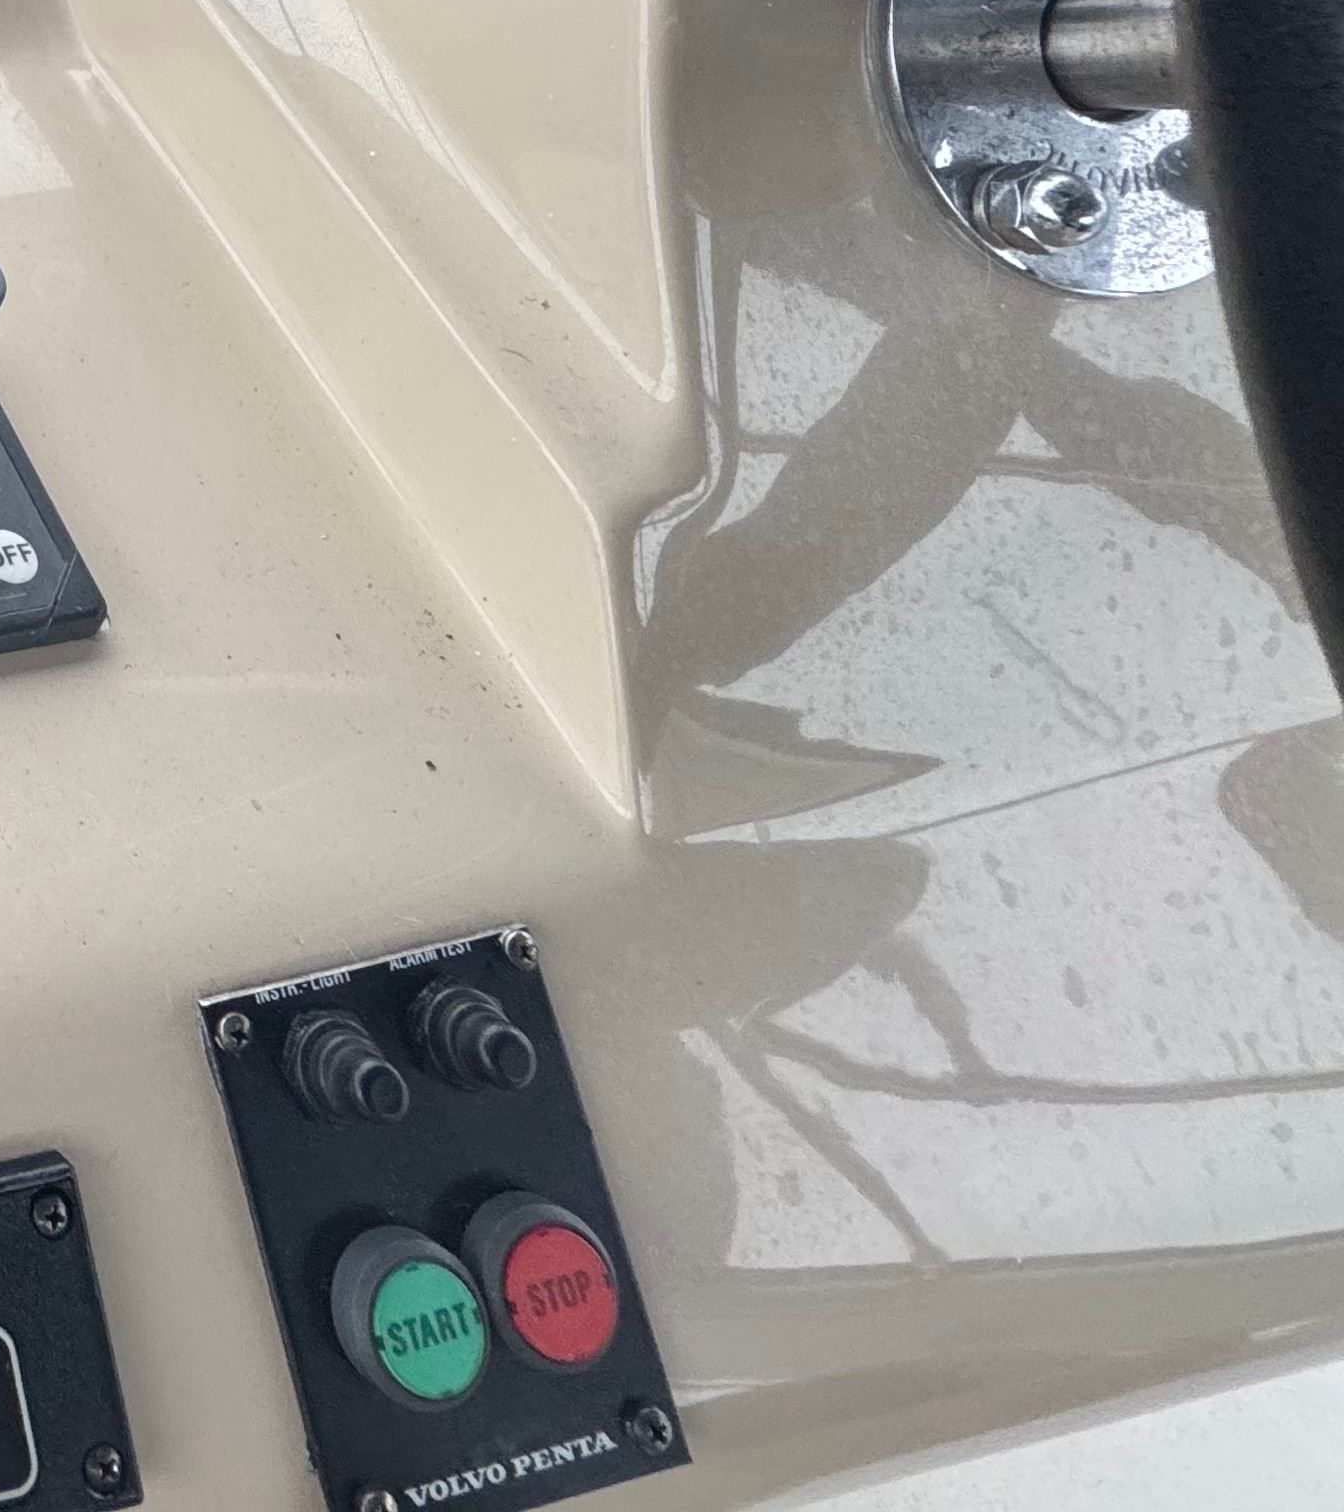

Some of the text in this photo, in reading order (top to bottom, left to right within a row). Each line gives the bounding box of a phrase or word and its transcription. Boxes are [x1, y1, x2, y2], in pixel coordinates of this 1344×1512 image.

[526, 1269, 592, 1317] STOP
[386, 1301, 471, 1357] START
[404, 1431, 619, 1508] VOLVO PENTA
